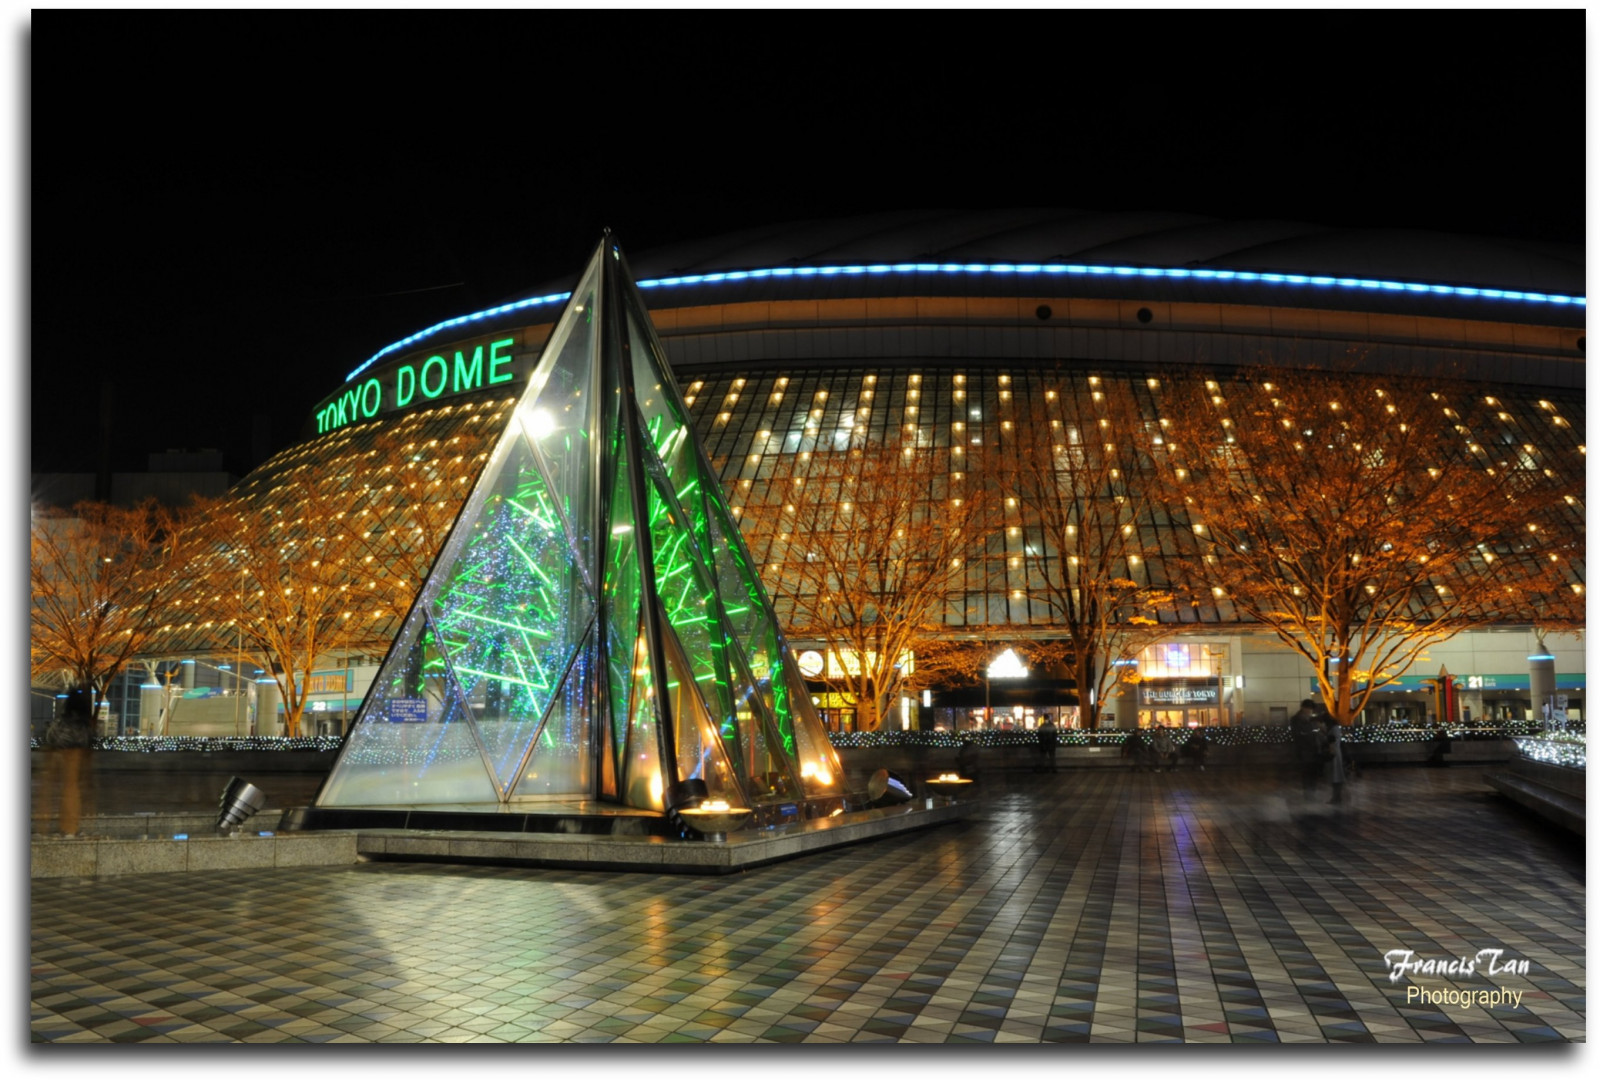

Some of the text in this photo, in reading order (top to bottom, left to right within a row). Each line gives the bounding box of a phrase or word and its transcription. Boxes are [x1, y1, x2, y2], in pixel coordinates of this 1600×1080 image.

[316, 338, 514, 433] TOKYO DOME
[1468, 675, 1483, 689] 21
[312, 701, 326, 711] 22
